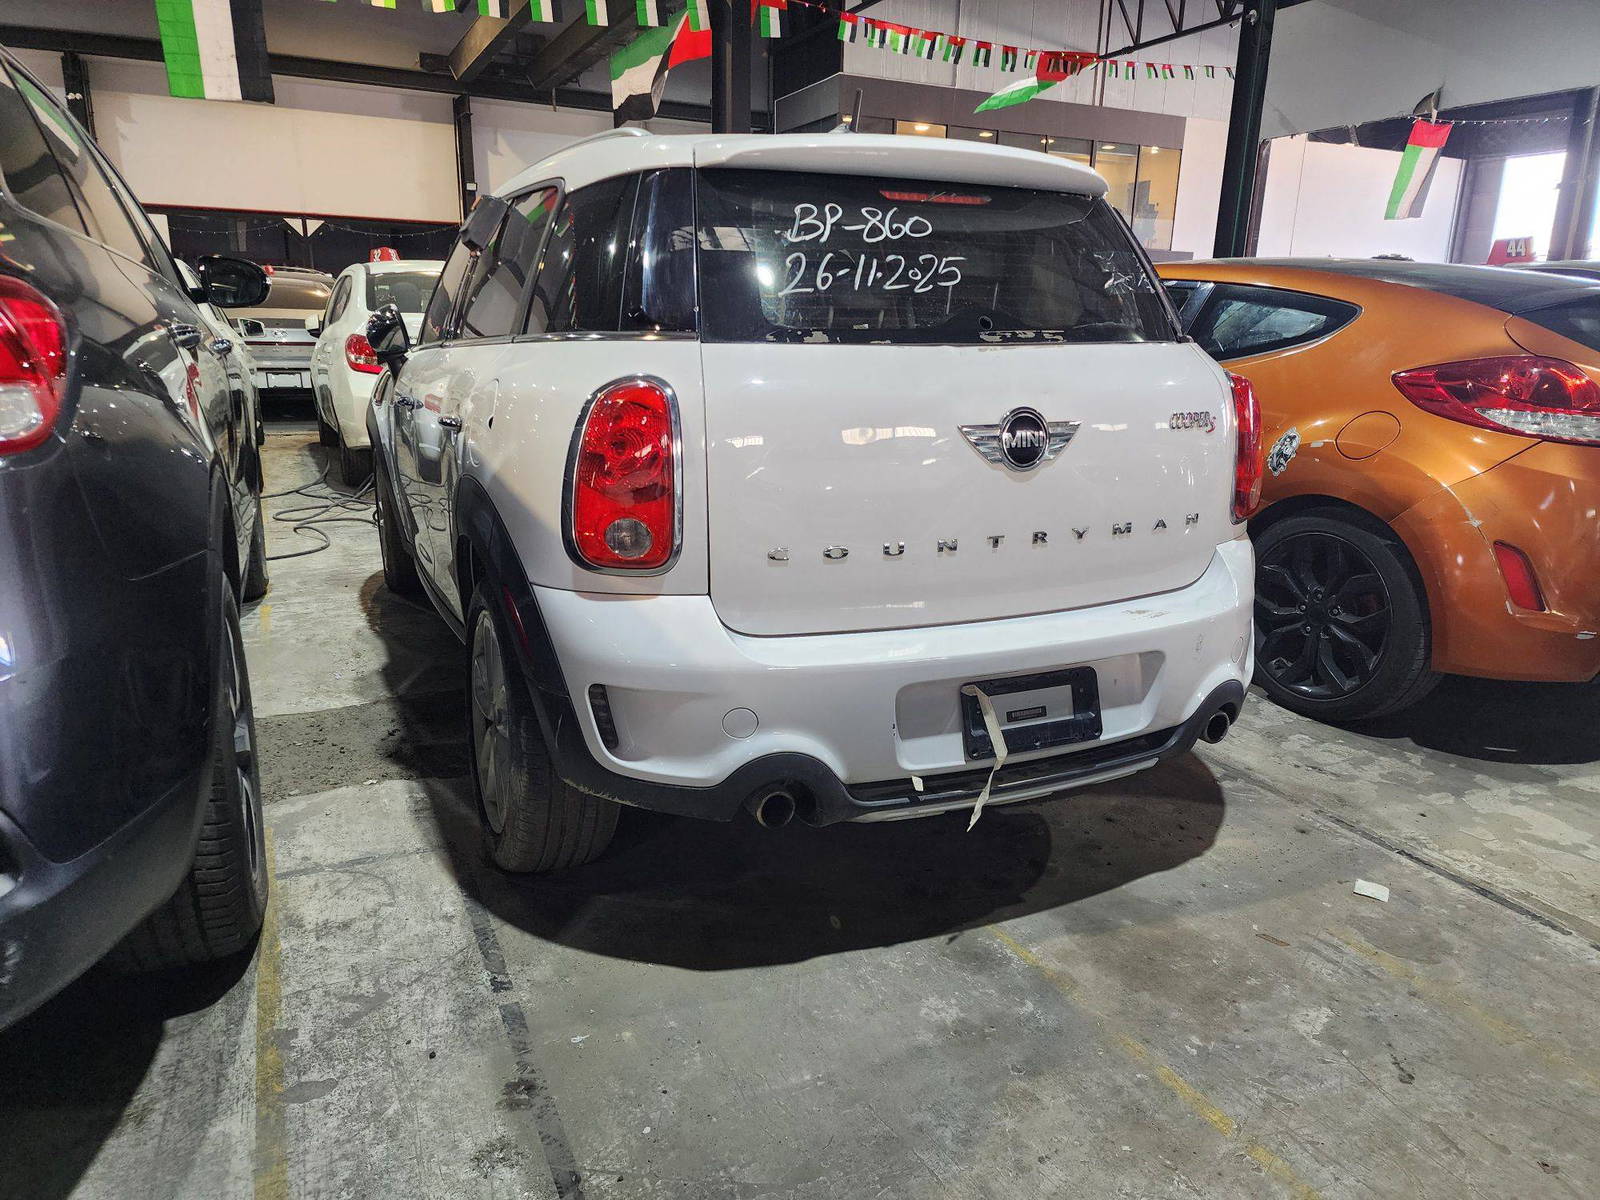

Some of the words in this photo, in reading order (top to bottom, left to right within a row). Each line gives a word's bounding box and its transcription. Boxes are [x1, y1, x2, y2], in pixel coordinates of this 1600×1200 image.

[1506, 239, 1527, 257] 44
[1004, 430, 1044, 449] MINI
[767, 512, 1199, 561] COUNTRYMAN
